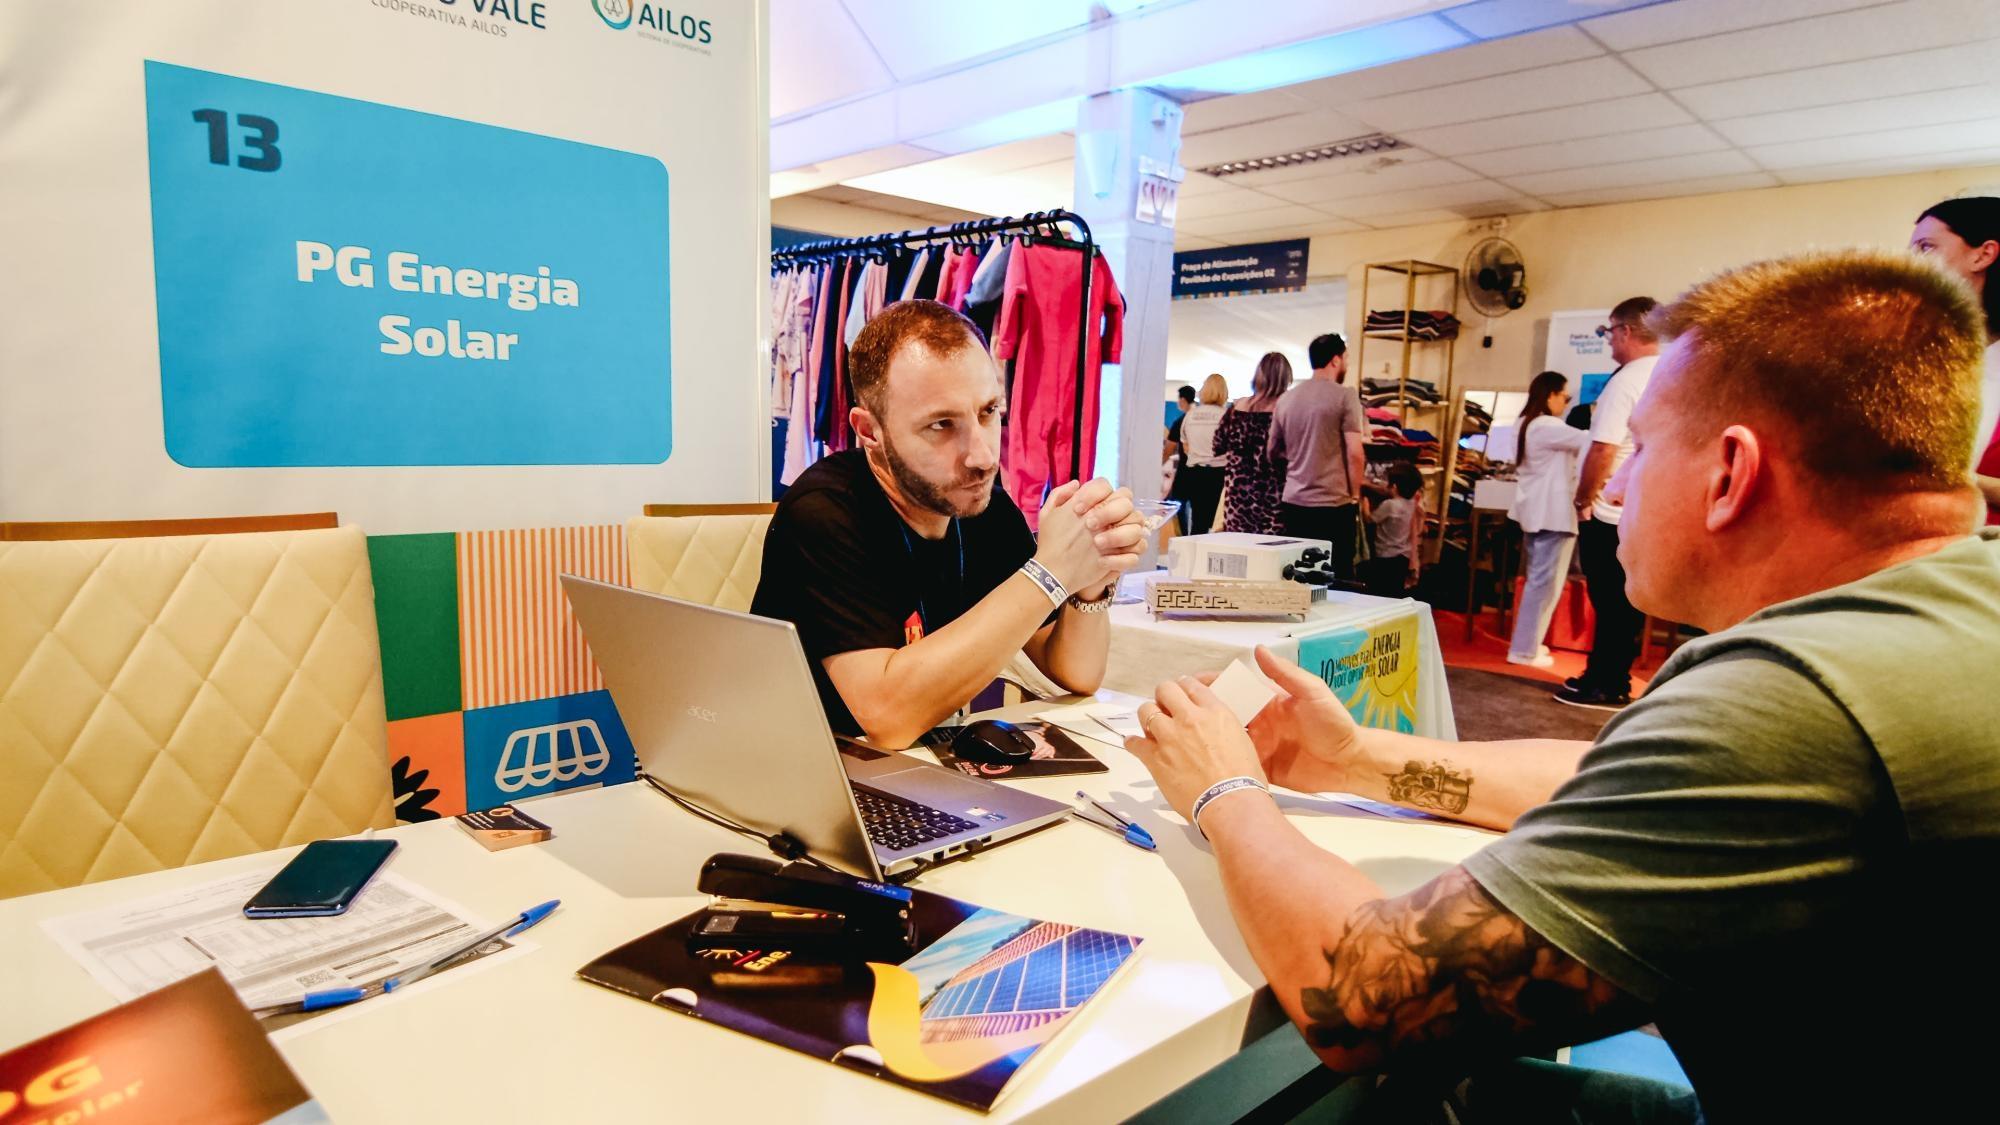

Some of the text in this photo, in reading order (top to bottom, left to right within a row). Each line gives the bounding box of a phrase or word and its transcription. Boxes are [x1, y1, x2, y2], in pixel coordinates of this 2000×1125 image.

[471, 19, 508, 38] AILOS
[638, 4, 712, 44] AILOS
[192, 108, 283, 173] 13
[296, 240, 580, 311] PG Energia
[1202, 261, 1211, 270] de
[1212, 273, 1221, 281] de
[1264, 268, 1275, 277] 02
[378, 314, 519, 361] Solar
[1373, 630, 1401, 659] ENERGIA
[1378, 652, 1399, 679] SOLAR
